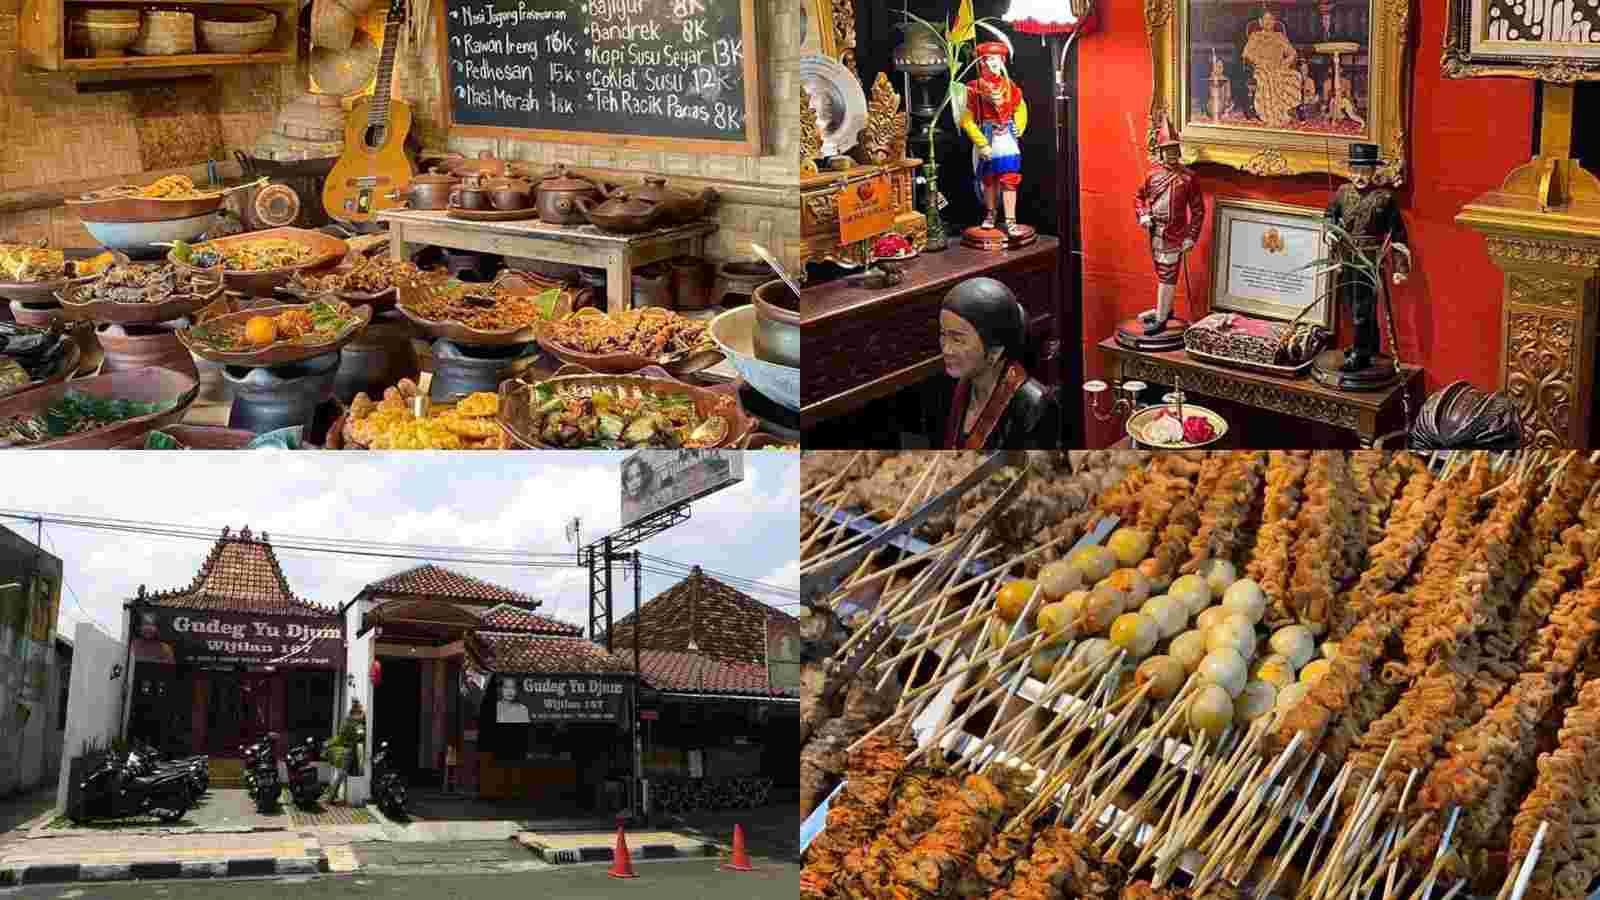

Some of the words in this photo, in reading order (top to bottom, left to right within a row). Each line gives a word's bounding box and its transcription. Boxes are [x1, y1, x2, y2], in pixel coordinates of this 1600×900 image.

[486, 4, 518, 28] Jagung
[590, 0, 644, 20] Bajigur
[672, 0, 705, 17] 8K
[591, 19, 661, 41] Bandrek
[683, 19, 709, 43] 8K
[464, 33, 503, 56] Rawon
[506, 32, 538, 60] Ireng
[592, 46, 624, 70] Kopi
[628, 44, 661, 66] Susu
[664, 45, 703, 71] Segar
[712, 39, 744, 67] 13K
[646, 68, 682, 92] Susu
[494, 86, 539, 112] Merah
[591, 88, 618, 113] Teh
[622, 91, 663, 115] Racik
[714, 102, 740, 129] 8K
[172, 616, 247, 638] Gudeg
[252, 621, 281, 638] Yu
[286, 623, 342, 641] Djum
[207, 640, 273, 654] Wijilan
[523, 678, 566, 696] Gudeg
[569, 679, 586, 693] Yu
[589, 679, 623, 697] Djum
